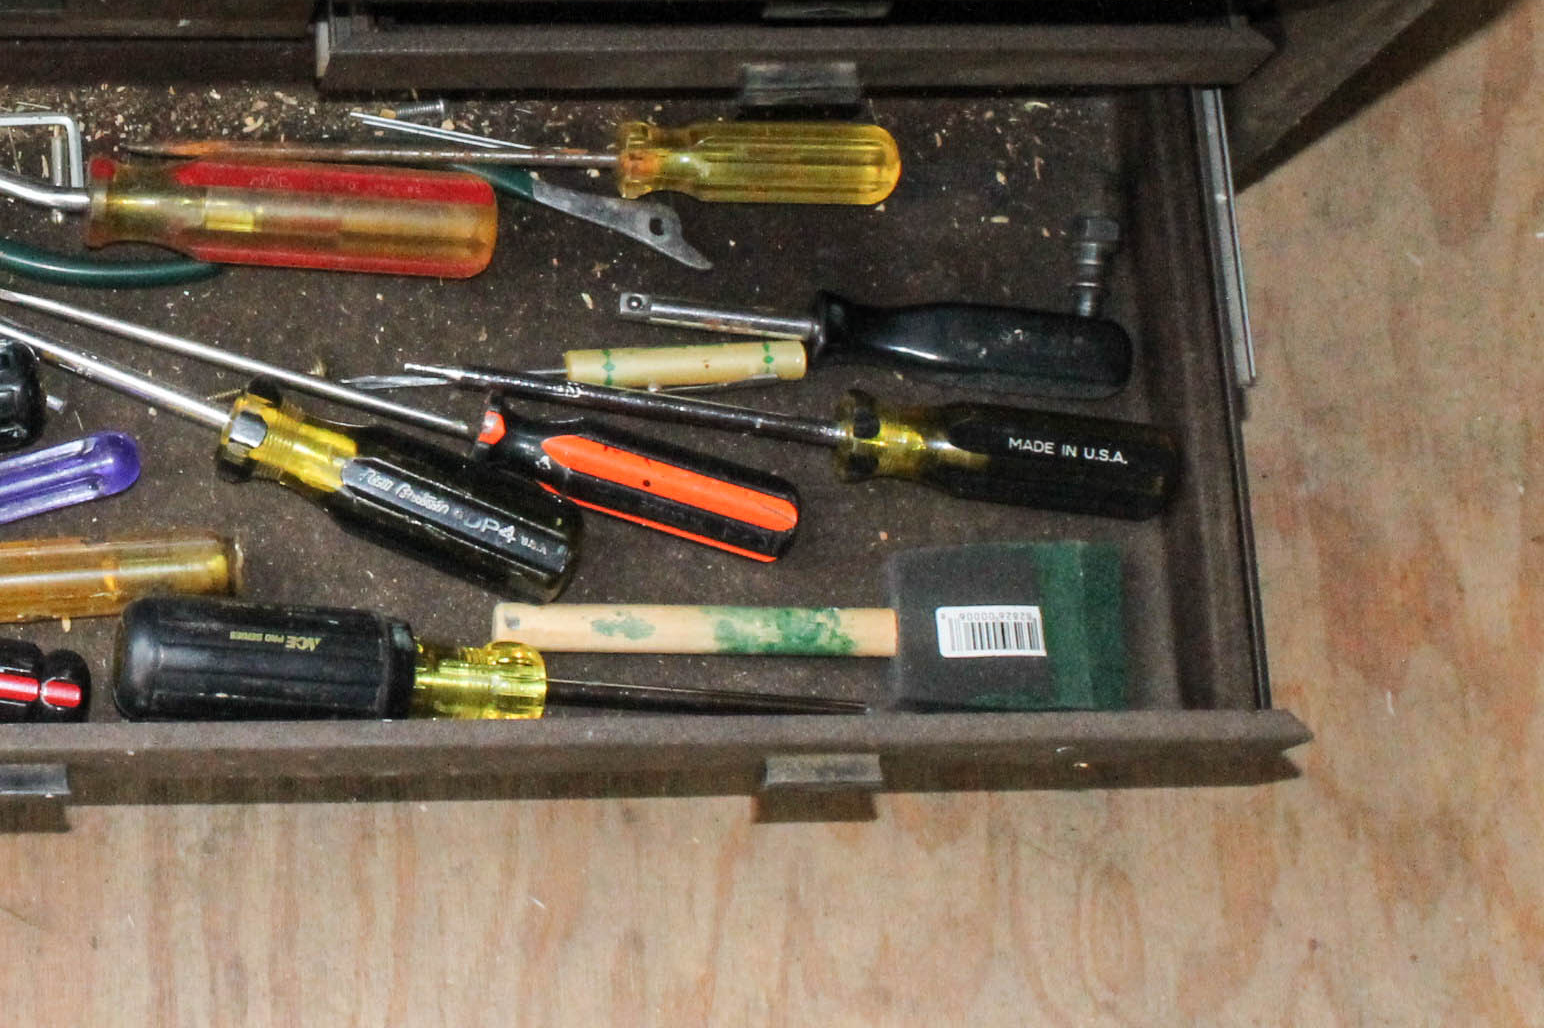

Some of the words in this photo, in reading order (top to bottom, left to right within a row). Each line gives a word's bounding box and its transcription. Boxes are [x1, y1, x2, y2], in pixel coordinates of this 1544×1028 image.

[1008, 437, 1055, 454] MADE
[1061, 444, 1077, 458] IN
[1083, 446, 1129, 464] U.S.A.
